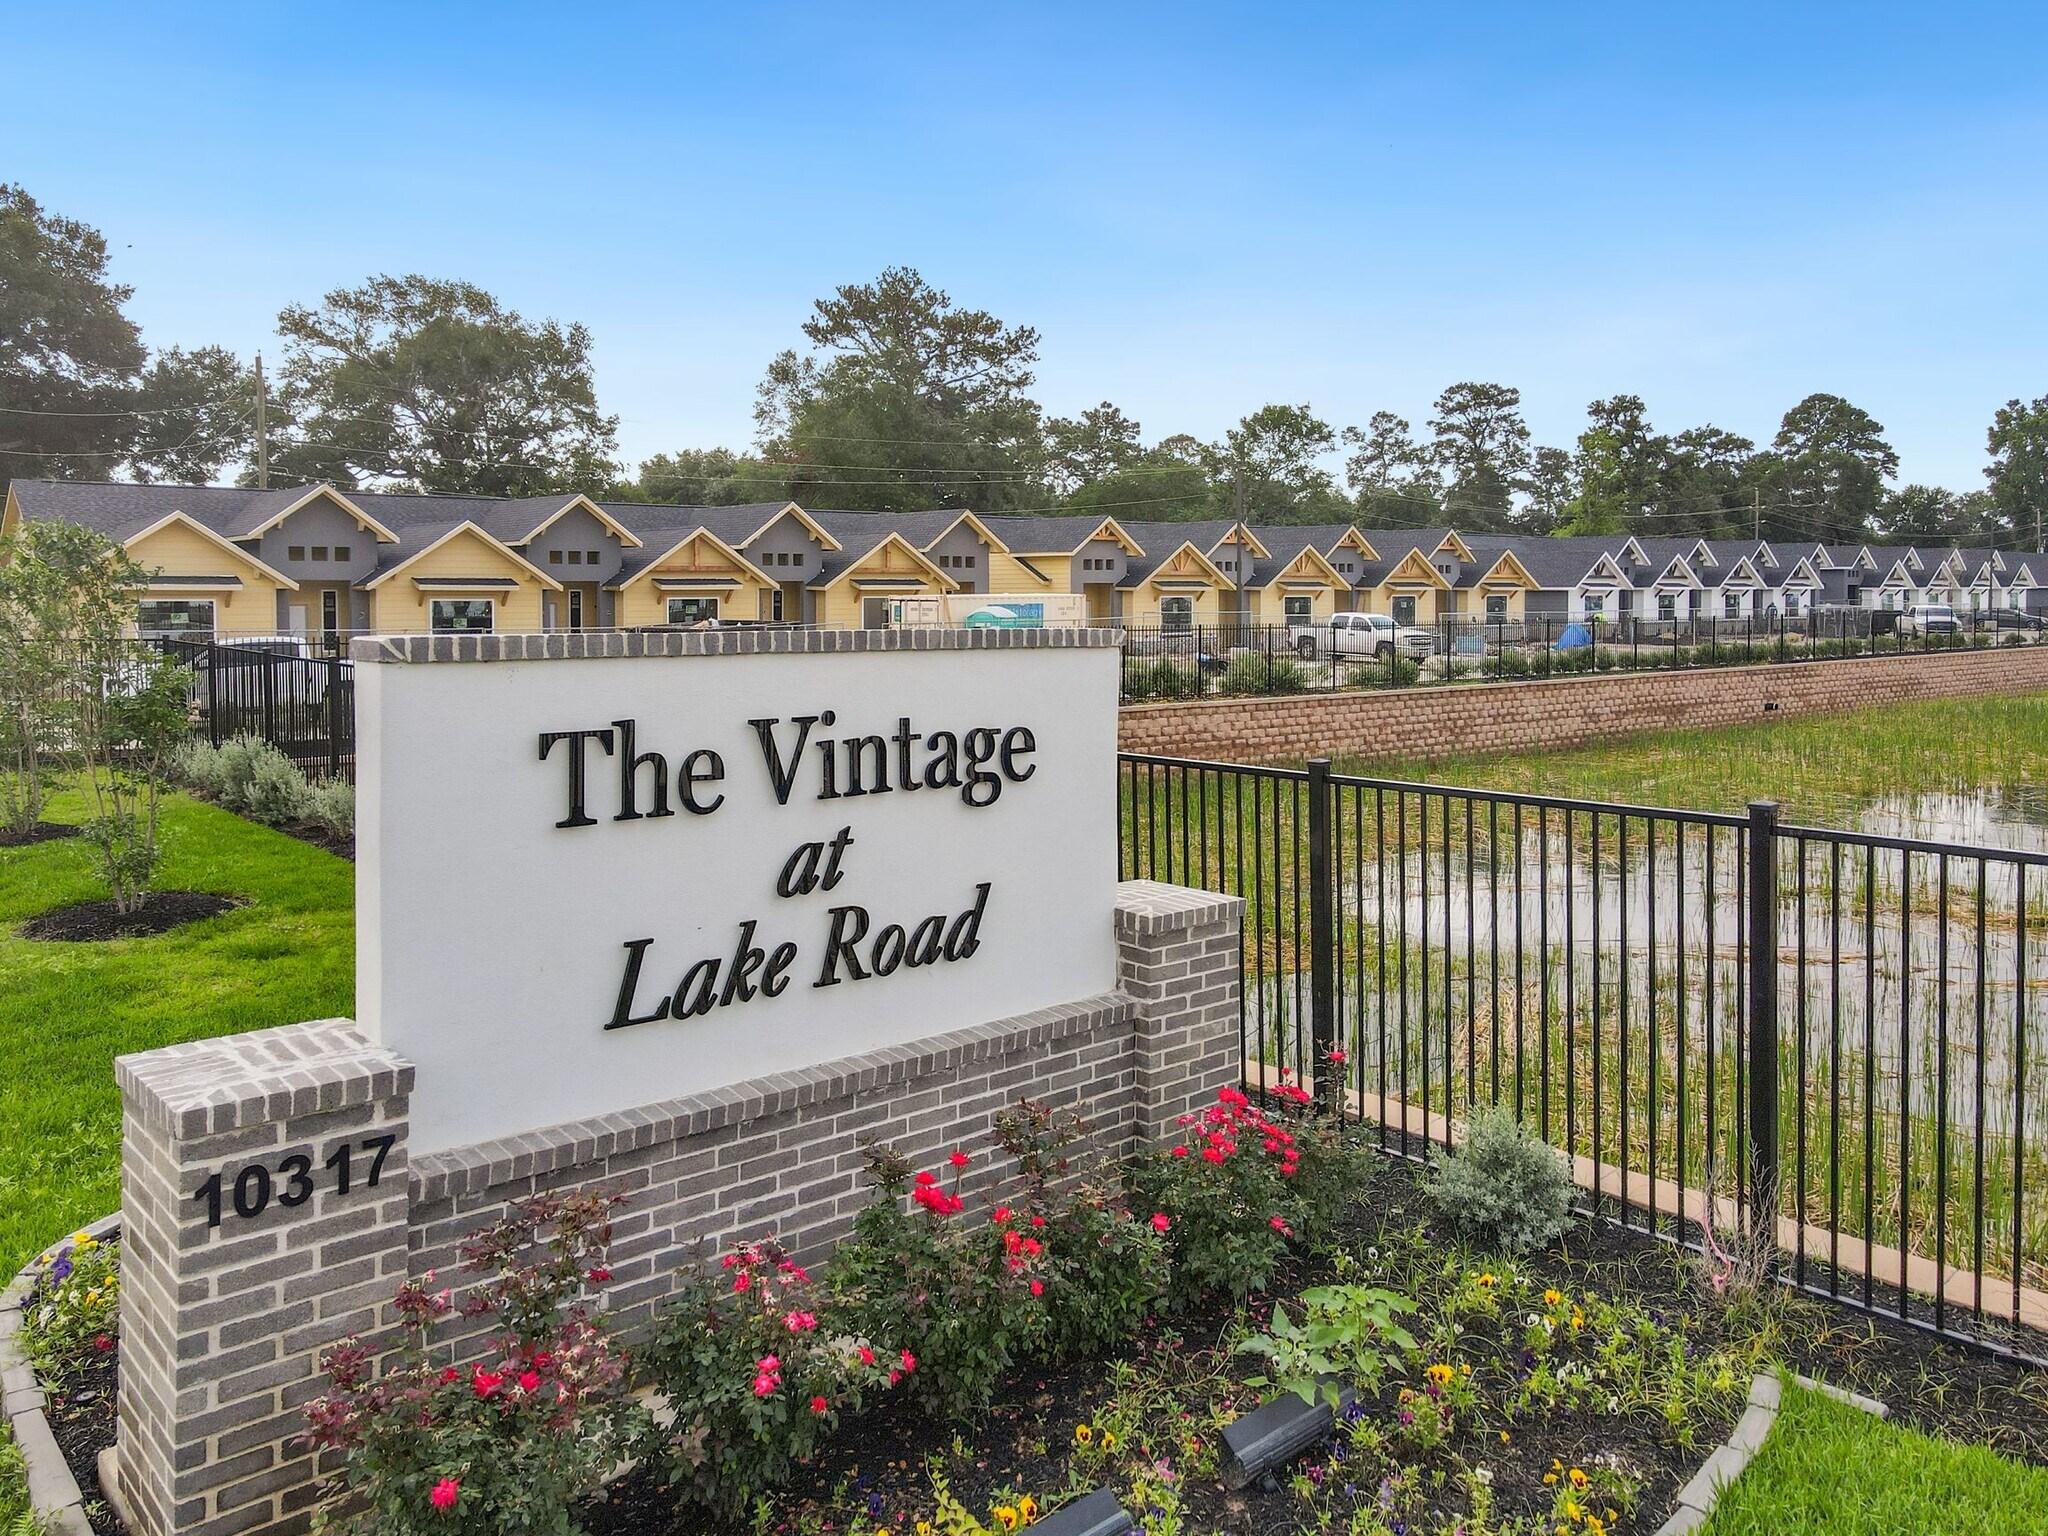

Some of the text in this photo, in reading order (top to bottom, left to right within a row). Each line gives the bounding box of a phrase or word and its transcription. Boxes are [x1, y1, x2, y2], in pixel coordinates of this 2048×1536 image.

[538, 710, 1037, 829] The Vintage
[776, 825, 855, 899] at
[603, 882, 992, 1031] Lake Road
[194, 1134, 396, 1228] 10317
